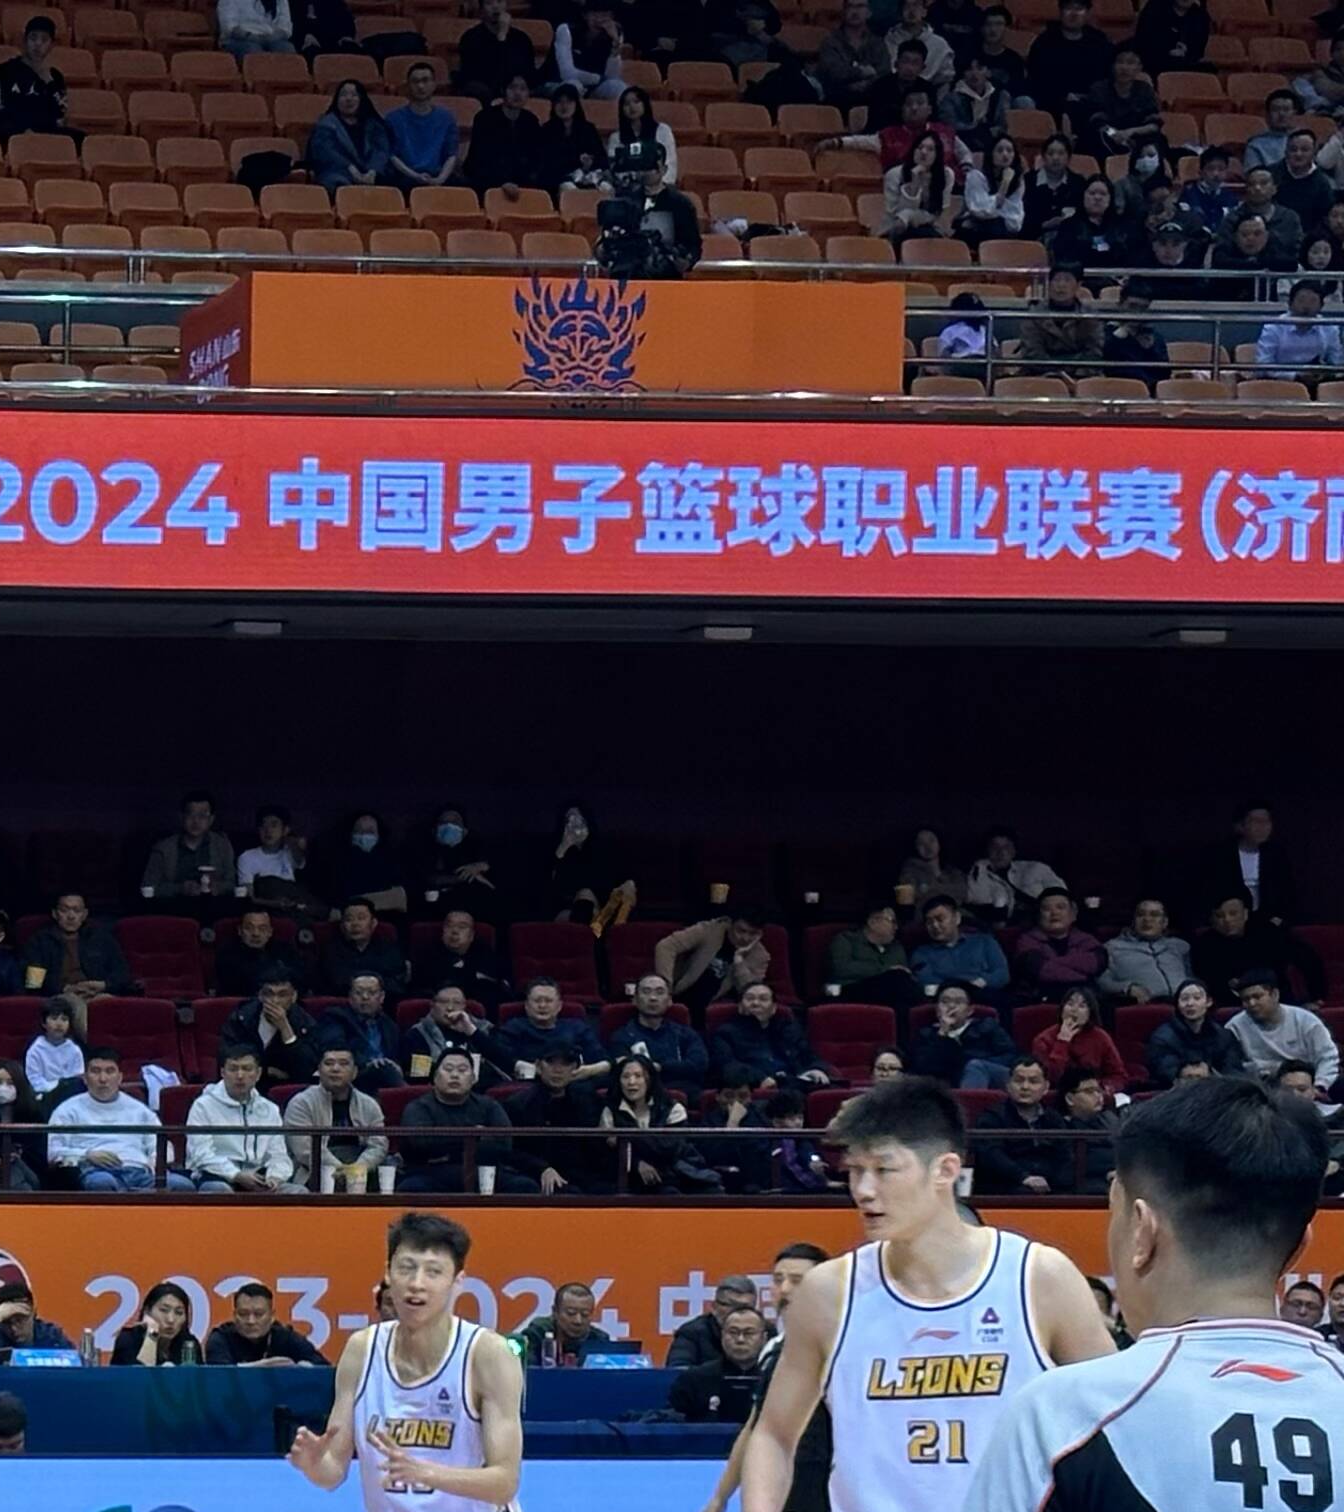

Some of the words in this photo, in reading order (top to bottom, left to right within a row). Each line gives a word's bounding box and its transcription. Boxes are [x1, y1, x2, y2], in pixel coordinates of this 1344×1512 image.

[268, 456, 1344, 567] 中国男子篮球职业联赛（济
[867, 1354, 1009, 1400] LIONS
[907, 1419, 969, 1464] 21
